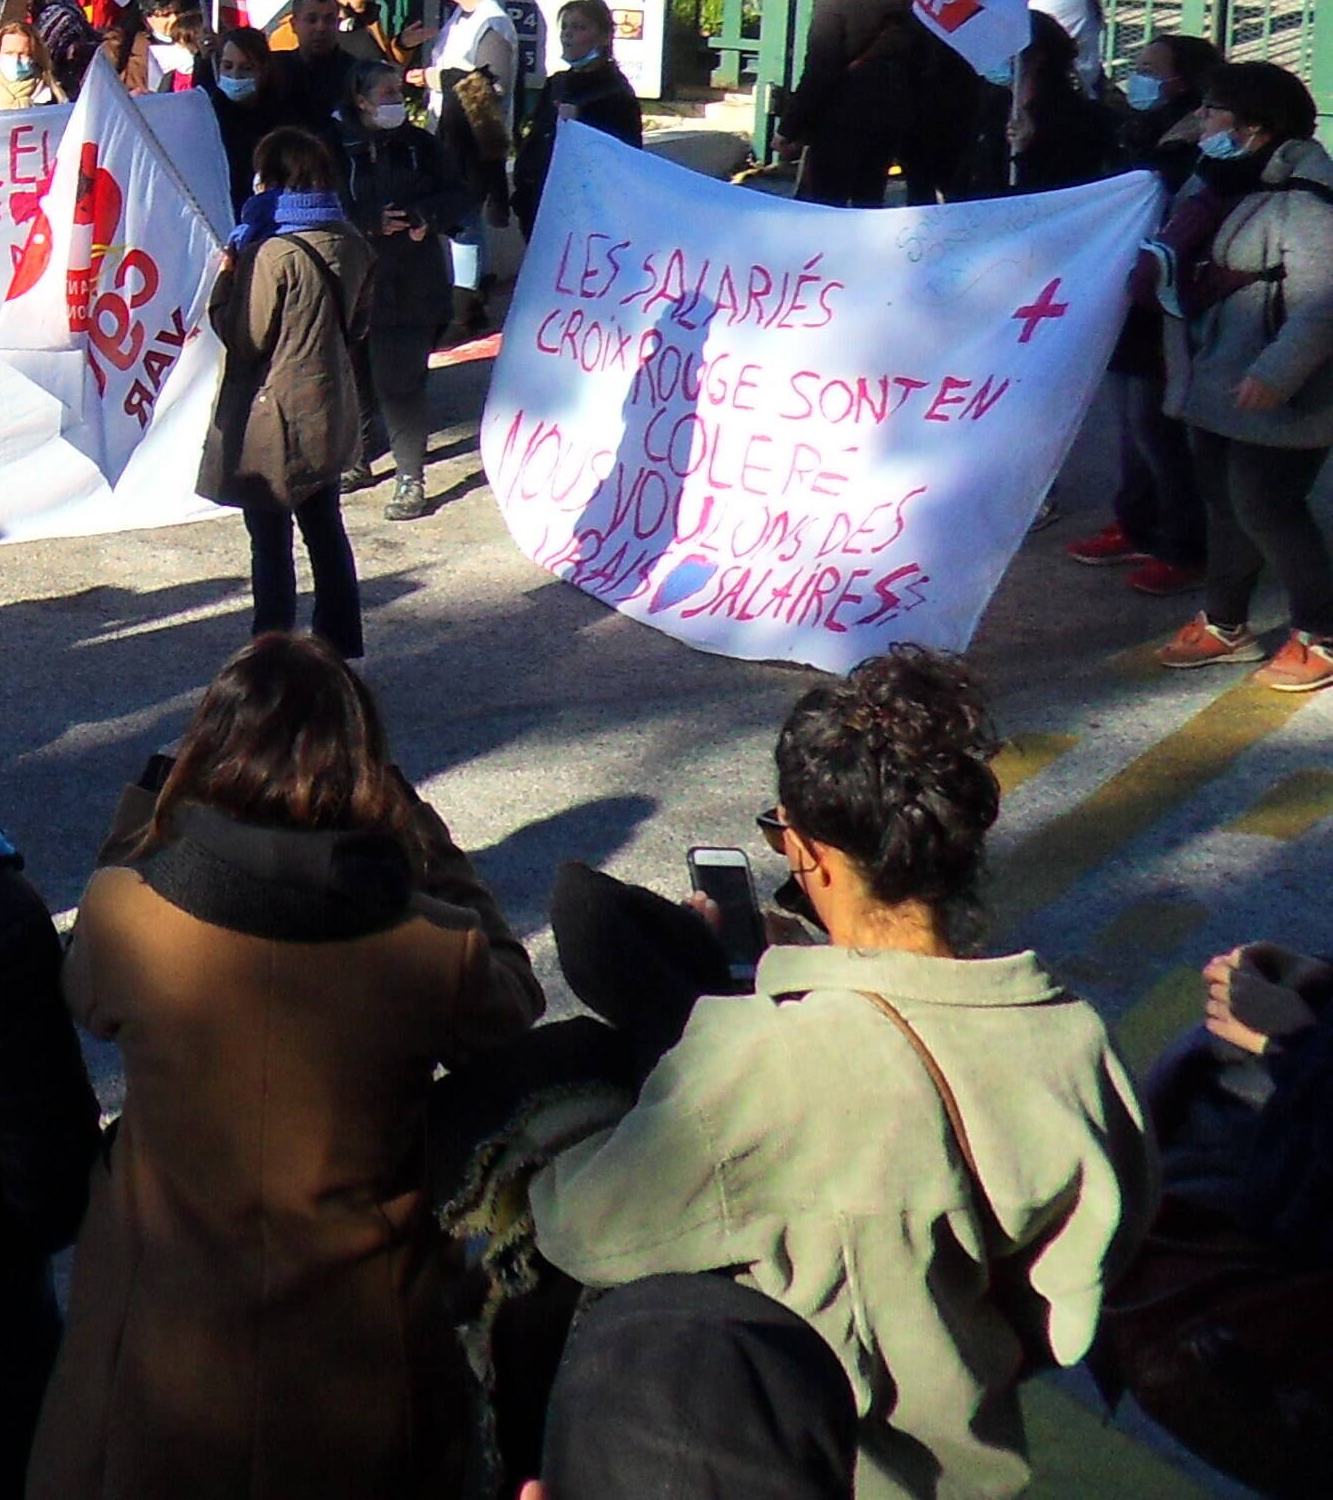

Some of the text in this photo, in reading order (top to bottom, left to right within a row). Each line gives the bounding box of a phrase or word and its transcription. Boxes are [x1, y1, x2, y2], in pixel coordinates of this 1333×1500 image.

[506, 8, 538, 29] P4
[555, 231, 631, 299] LES
[535, 307, 635, 373] CROIX
[632, 328, 762, 410] ROUGE
[925, 376, 1011, 422] EN
[497, 408, 612, 512] NOUS
[813, 485, 928, 559] DES
